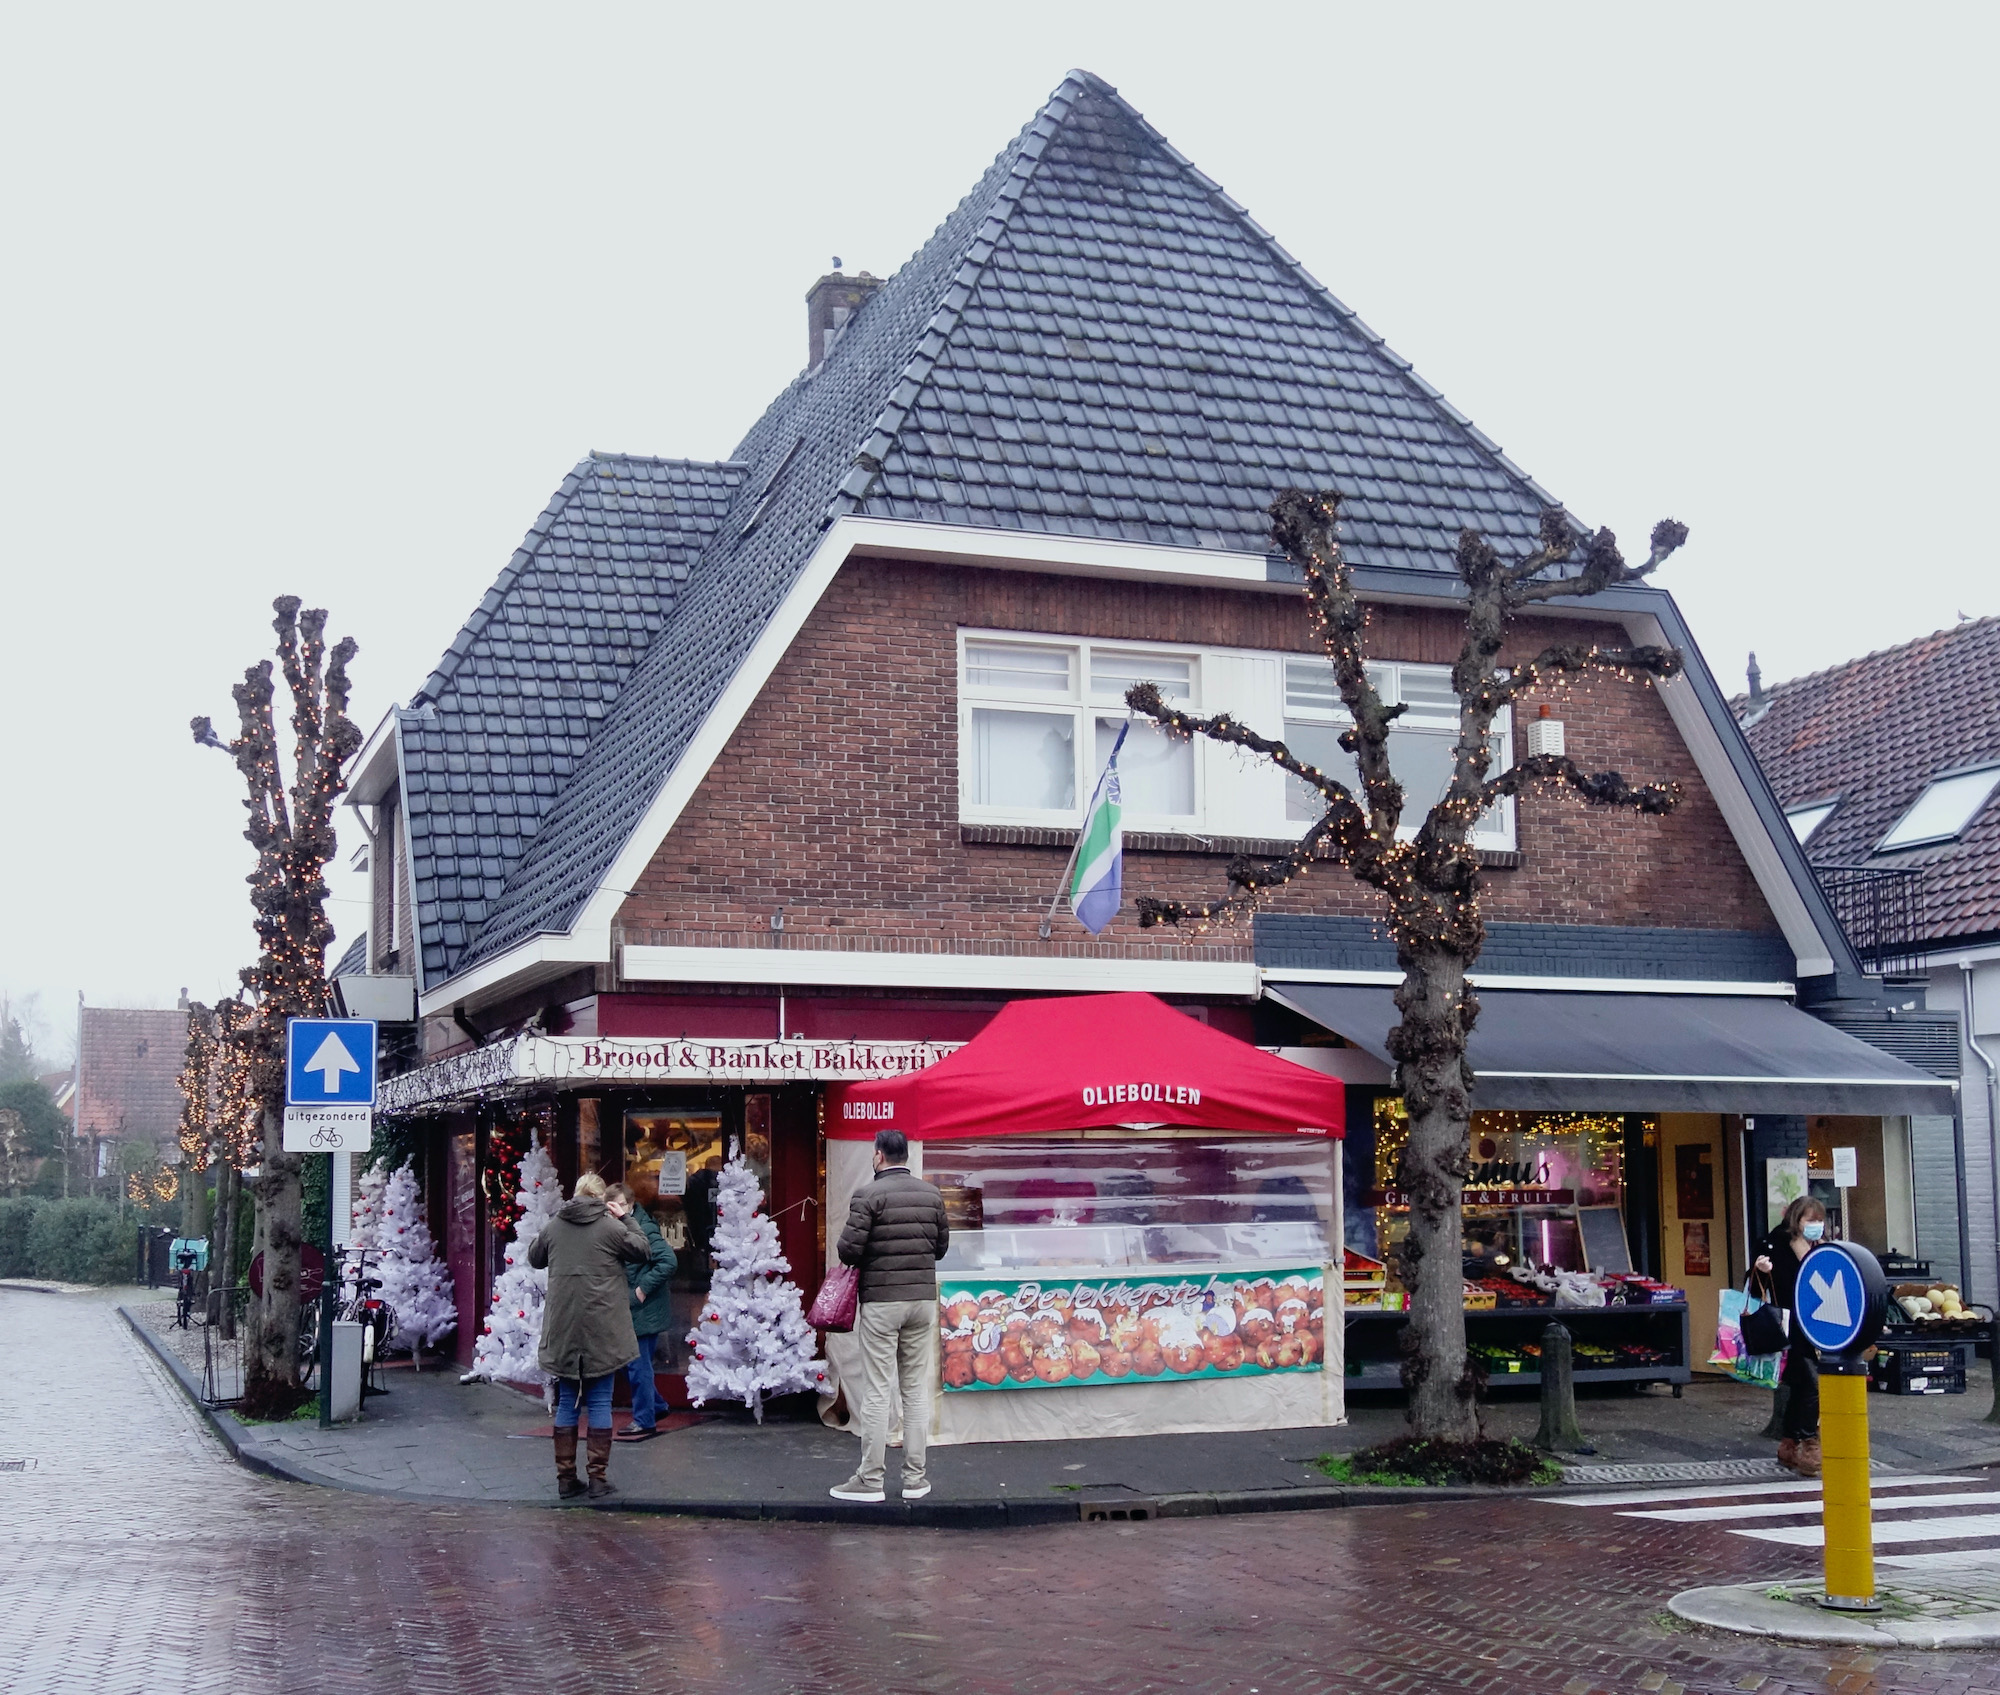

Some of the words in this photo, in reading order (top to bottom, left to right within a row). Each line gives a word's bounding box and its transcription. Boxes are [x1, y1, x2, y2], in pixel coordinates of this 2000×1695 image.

[582, 1044, 669, 1067] Brood
[679, 1046, 700, 1067] &
[708, 1046, 805, 1069] Banket
[813, 1048, 925, 1071] Bakkerij
[1082, 1083, 1200, 1106] OLIEBOLLEN
[288, 1112, 367, 1123] uitgezonderd
[843, 1101, 895, 1120] OLIEBOLLEN
[1479, 1191, 1490, 1204] &
[1498, 1191, 1553, 1204] FRUIT
[1012, 1282, 1058, 1311] De
[1065, 1275, 1217, 1309] lekkerste!
